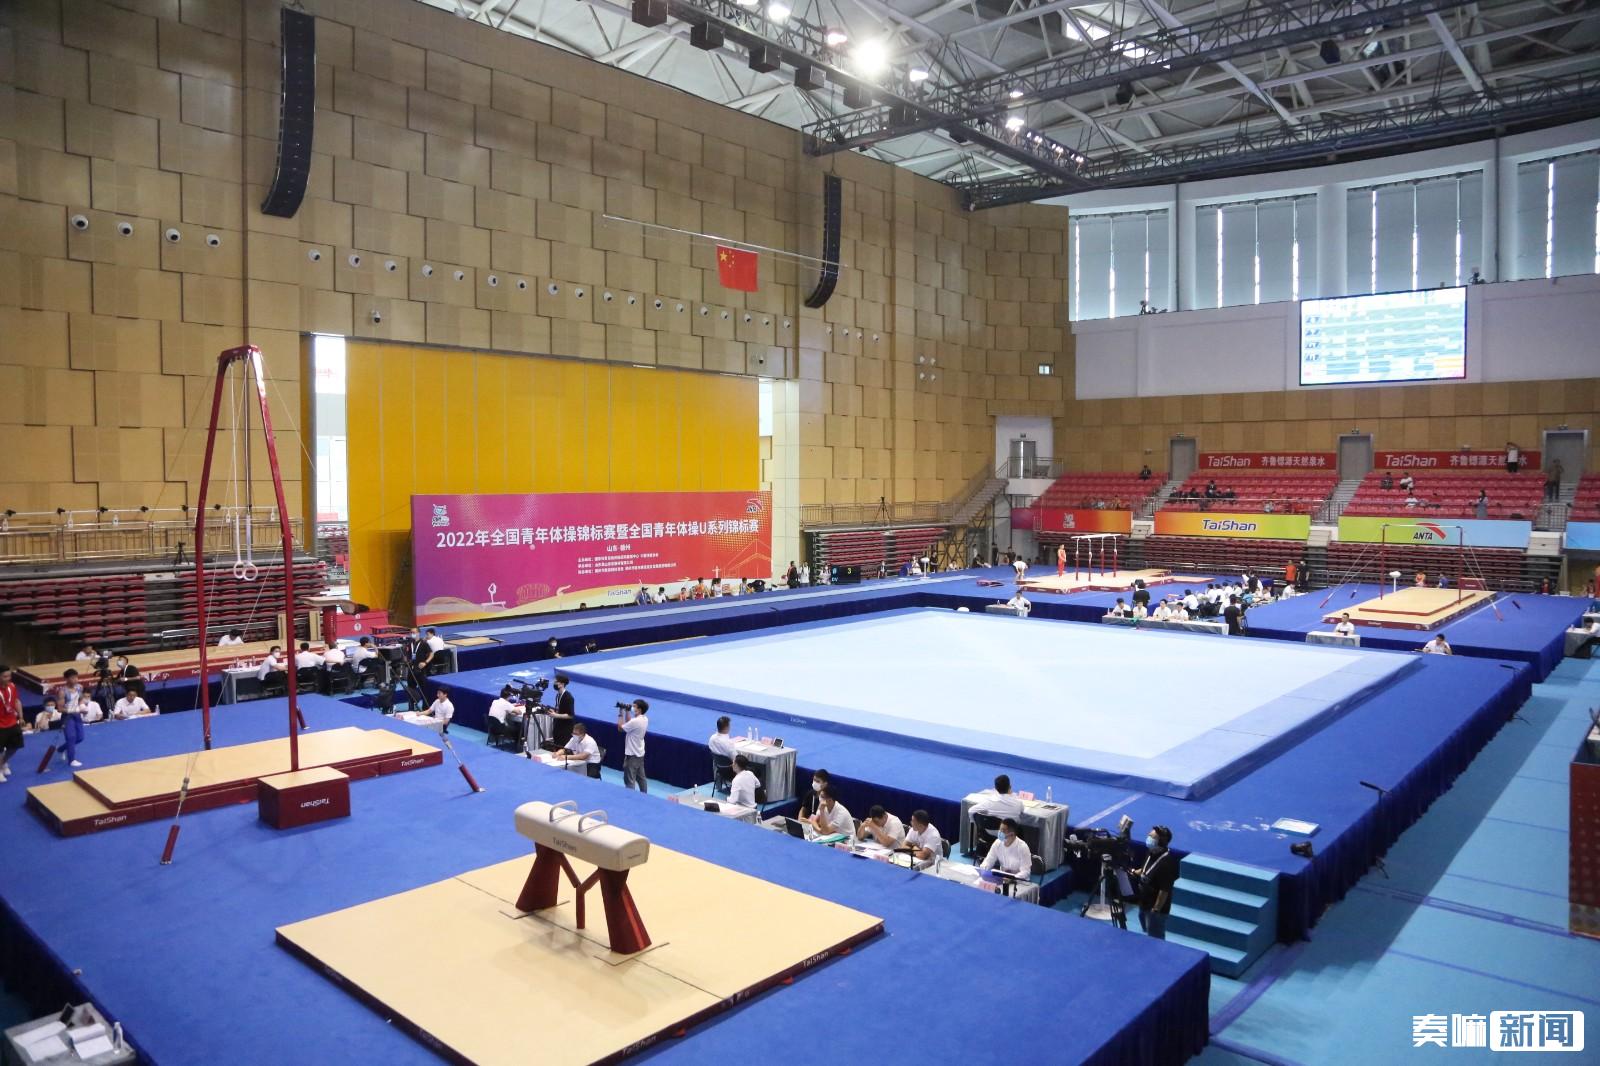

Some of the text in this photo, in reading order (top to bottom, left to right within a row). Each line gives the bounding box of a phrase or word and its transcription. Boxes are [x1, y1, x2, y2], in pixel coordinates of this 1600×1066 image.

[1208, 456, 1251, 467] TaiShan
[1385, 455, 1437, 467] TaiShan
[1203, 519, 1257, 531] TaiShan
[436, 519, 759, 548] 2022年全国青年体操锦标赛暨全国青年体操U系列锦标赛
[1413, 531, 1433, 540] ANTA
[300, 797, 331, 808] TaiShan
[94, 814, 128, 826] TaiShan
[803, 950, 829, 968] TaiShan
